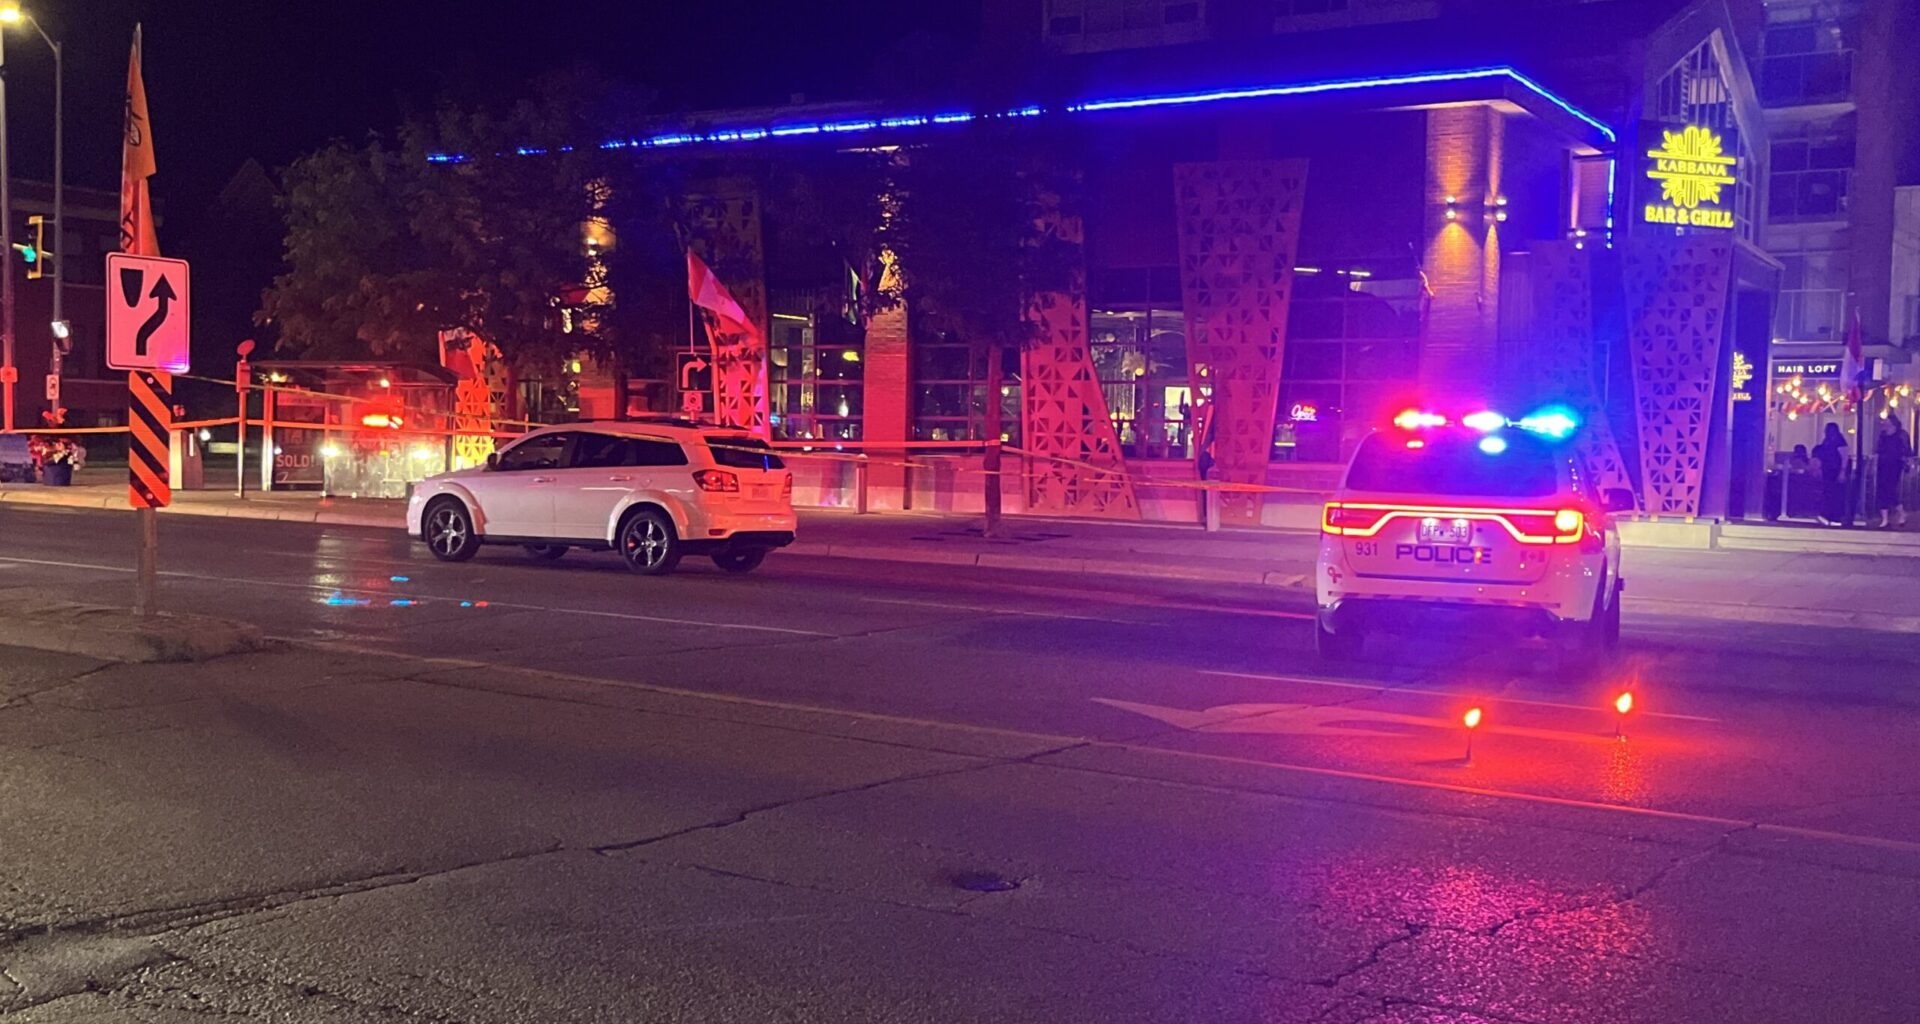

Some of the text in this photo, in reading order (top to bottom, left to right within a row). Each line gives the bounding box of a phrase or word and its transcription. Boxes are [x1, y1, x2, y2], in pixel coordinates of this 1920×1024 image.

[1657, 159, 1727, 176] KABBANA
[1645, 205, 1734, 228] BAR & GRILL
[1778, 365, 1837, 373] HAIR LOFT
[276, 454, 315, 468] SOLD!
[1355, 542, 1378, 556] 931
[1396, 544, 1492, 564] POLICE
